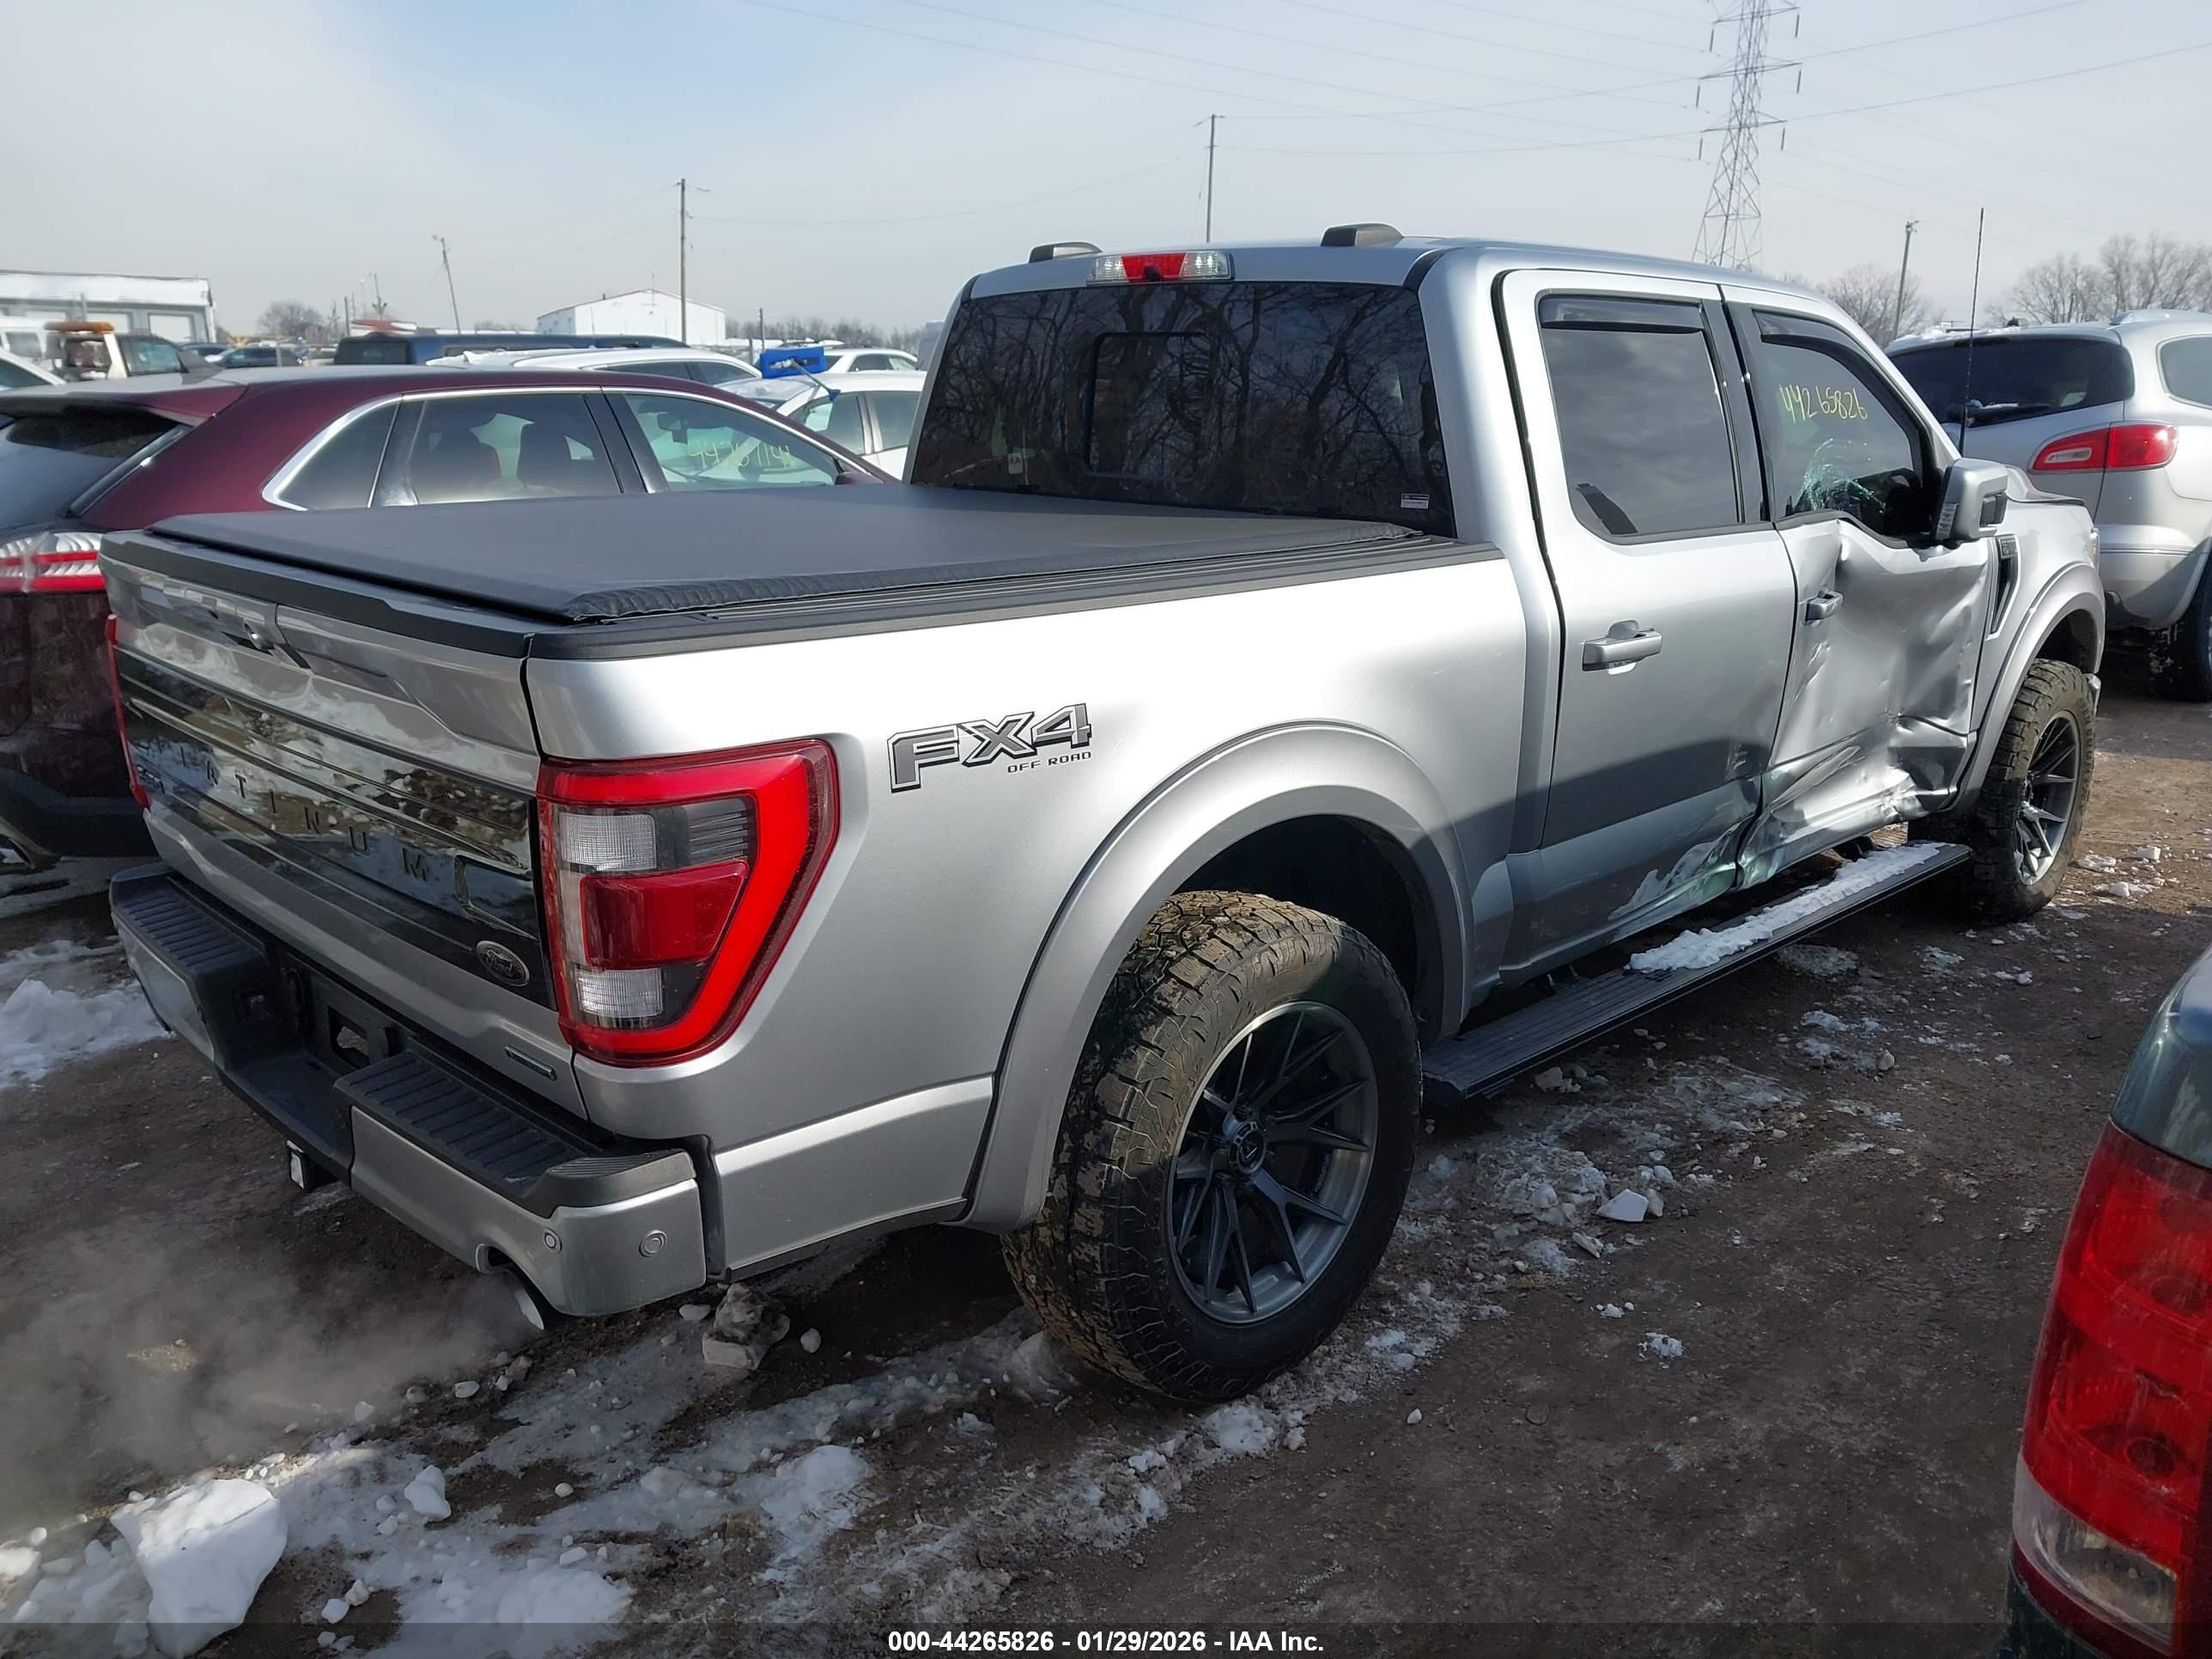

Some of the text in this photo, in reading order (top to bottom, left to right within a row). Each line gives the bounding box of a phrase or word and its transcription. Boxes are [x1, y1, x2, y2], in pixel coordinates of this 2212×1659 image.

[1779, 384, 1869, 424] 44265826
[887, 702, 1093, 793] FX4
[1006, 750, 1093, 775] OFF ROAD
